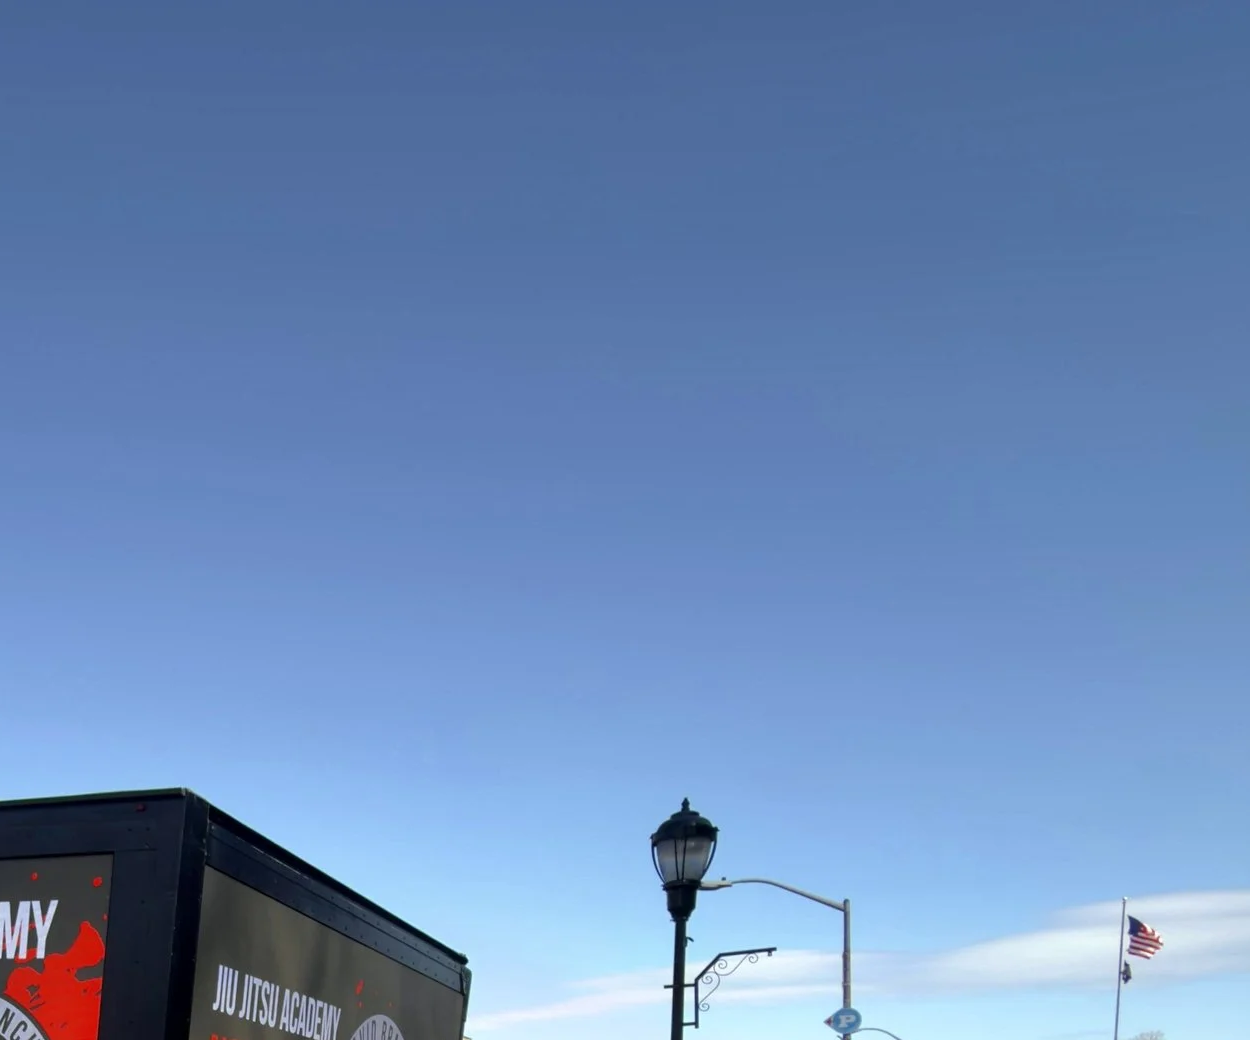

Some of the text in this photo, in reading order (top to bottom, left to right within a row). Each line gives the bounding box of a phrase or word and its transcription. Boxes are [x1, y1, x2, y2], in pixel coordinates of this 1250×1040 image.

[212, 964, 239, 1016] JIU
[239, 974, 280, 1028] JITSU
[838, 1014, 856, 1028] P
